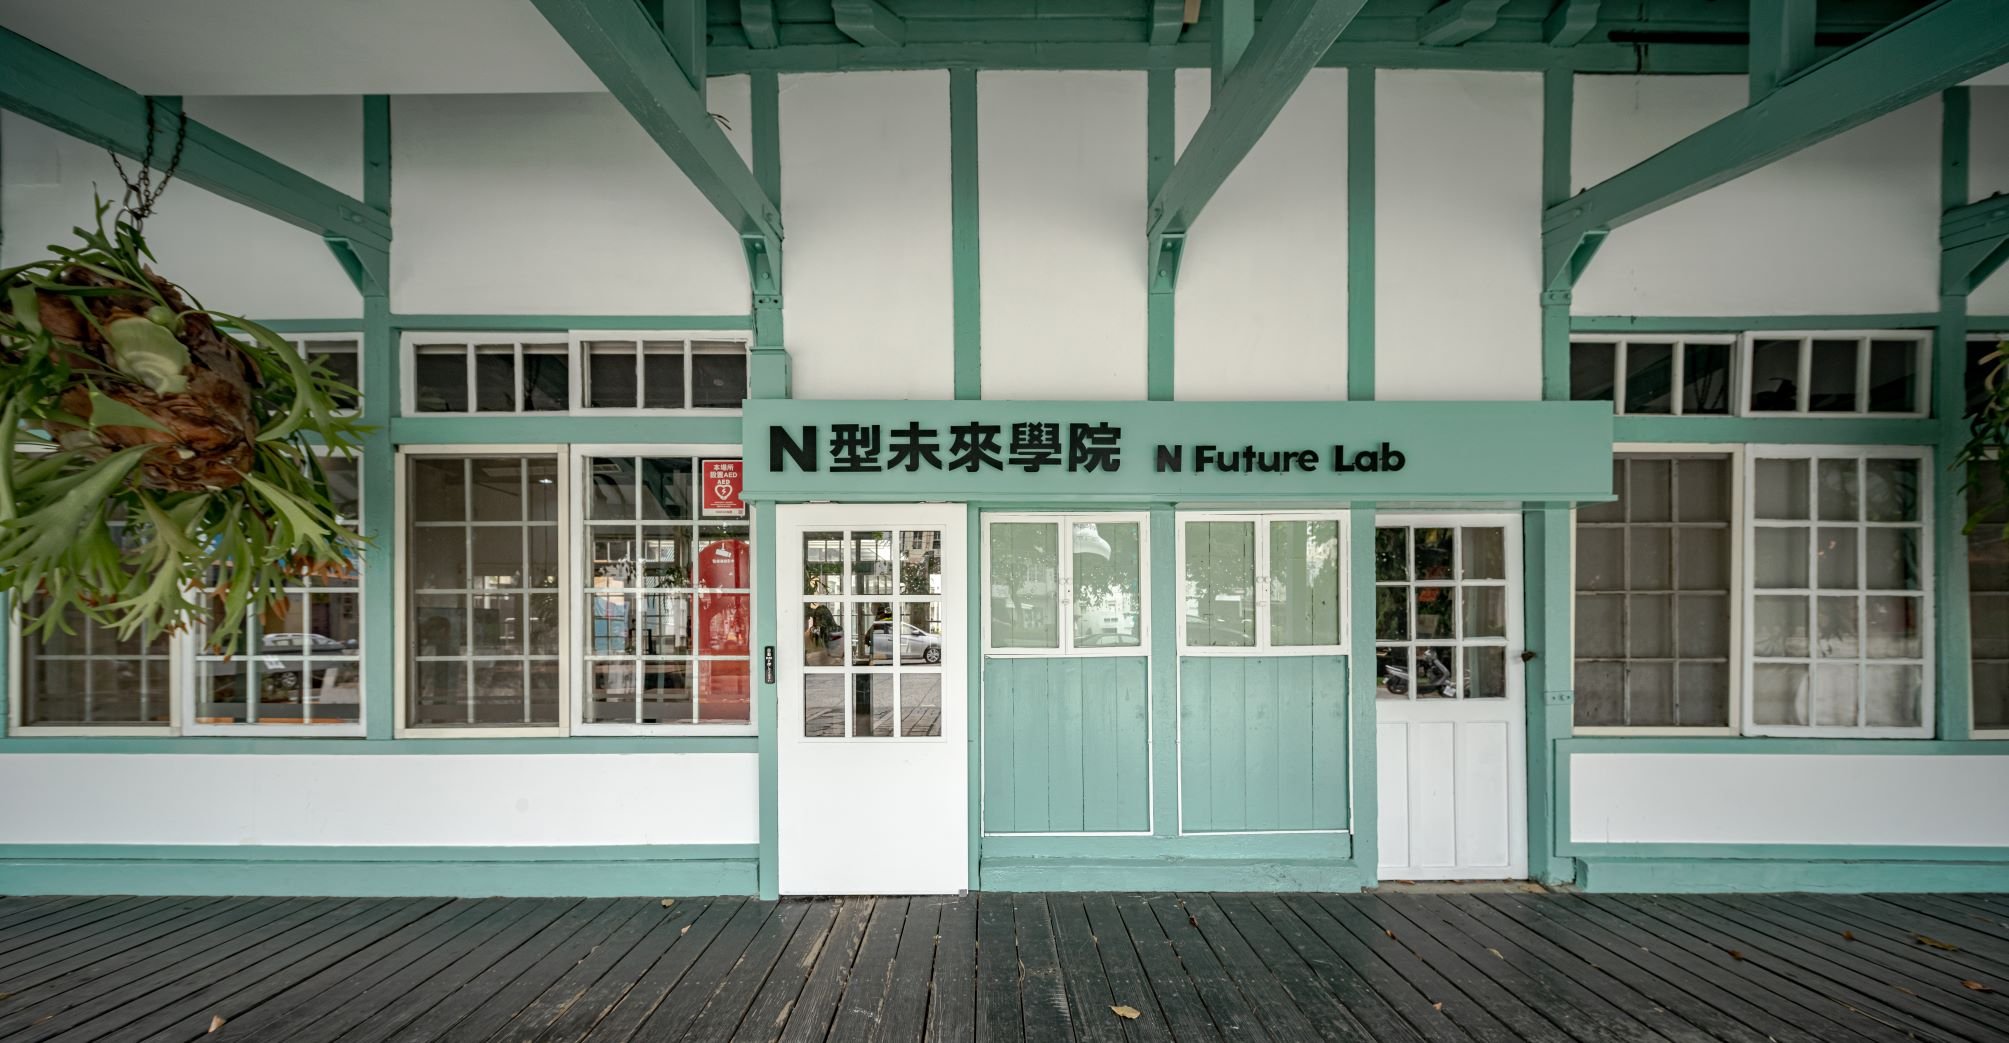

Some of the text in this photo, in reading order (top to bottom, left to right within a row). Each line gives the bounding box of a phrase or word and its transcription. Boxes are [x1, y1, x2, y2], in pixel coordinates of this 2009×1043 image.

[1156, 441, 1407, 473] N Future Lab
